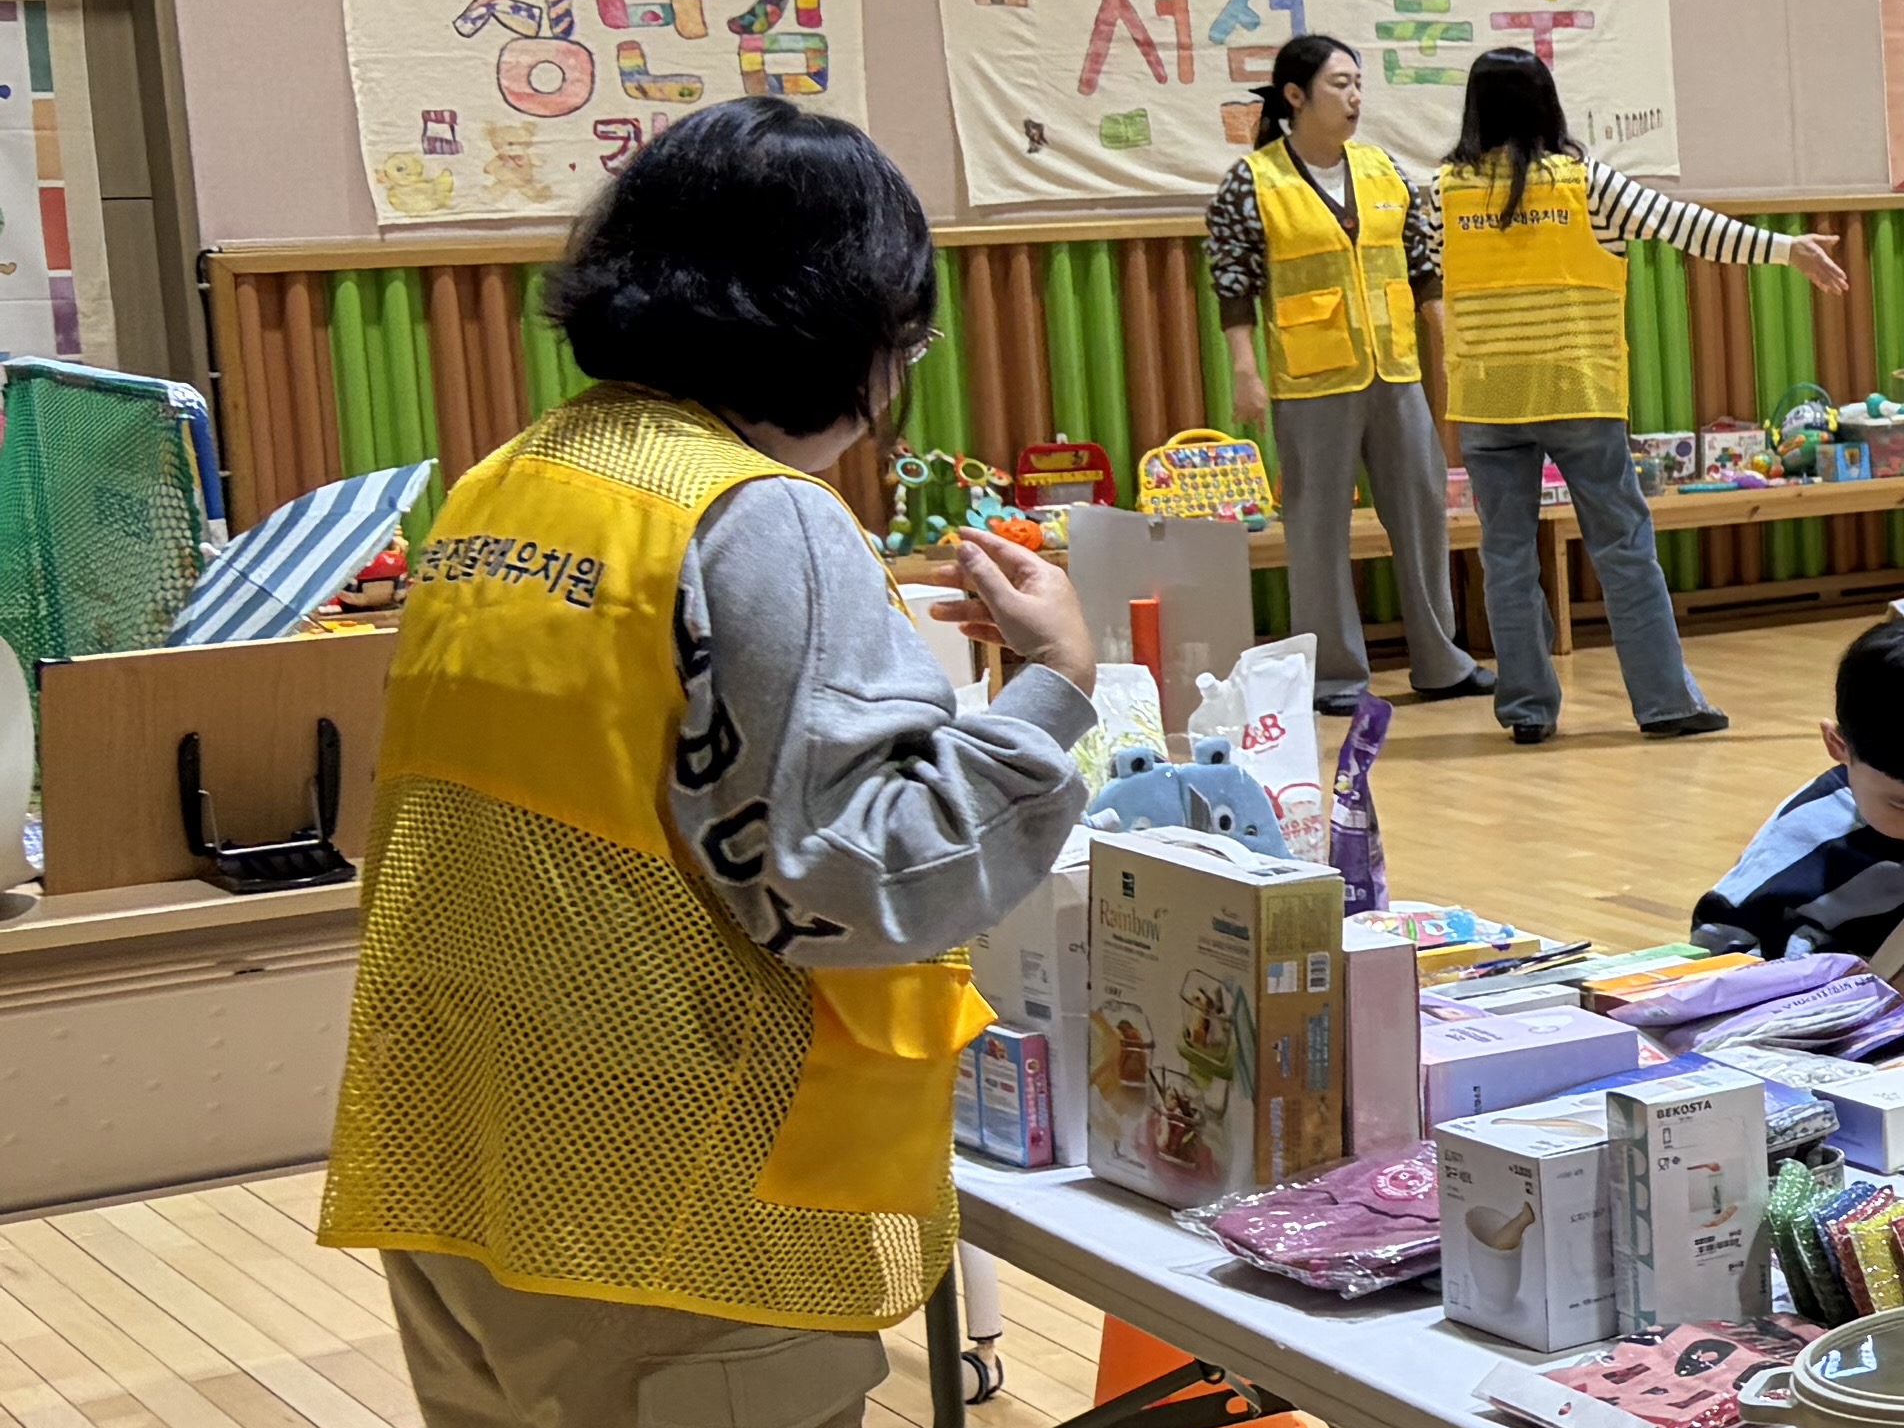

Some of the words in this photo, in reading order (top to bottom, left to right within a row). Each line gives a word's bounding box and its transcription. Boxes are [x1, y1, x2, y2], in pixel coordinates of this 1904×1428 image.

[1457, 208, 1570, 231] 창원진래유치원
[418, 535, 607, 609] 원진달래유치원
[1099, 898, 1161, 942] Rainbow
[1656, 1099, 1713, 1120] BEKOSTA
